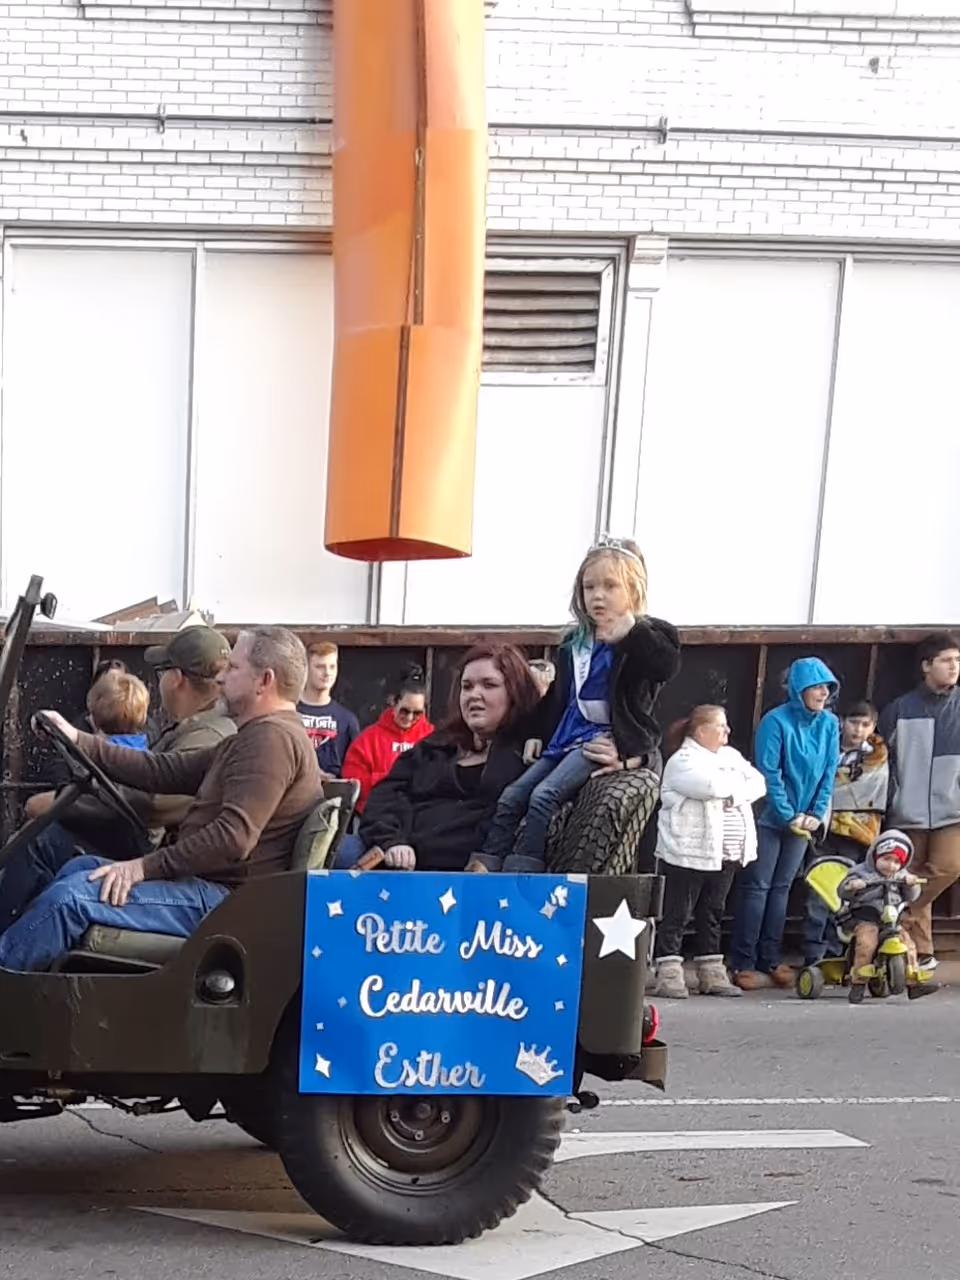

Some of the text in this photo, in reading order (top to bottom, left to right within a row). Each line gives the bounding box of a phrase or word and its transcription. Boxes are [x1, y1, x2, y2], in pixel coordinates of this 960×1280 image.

[356, 913, 543, 959] Petite Miss
[359, 975, 528, 1020] Cedarville
[374, 1042, 485, 1088] Esther
